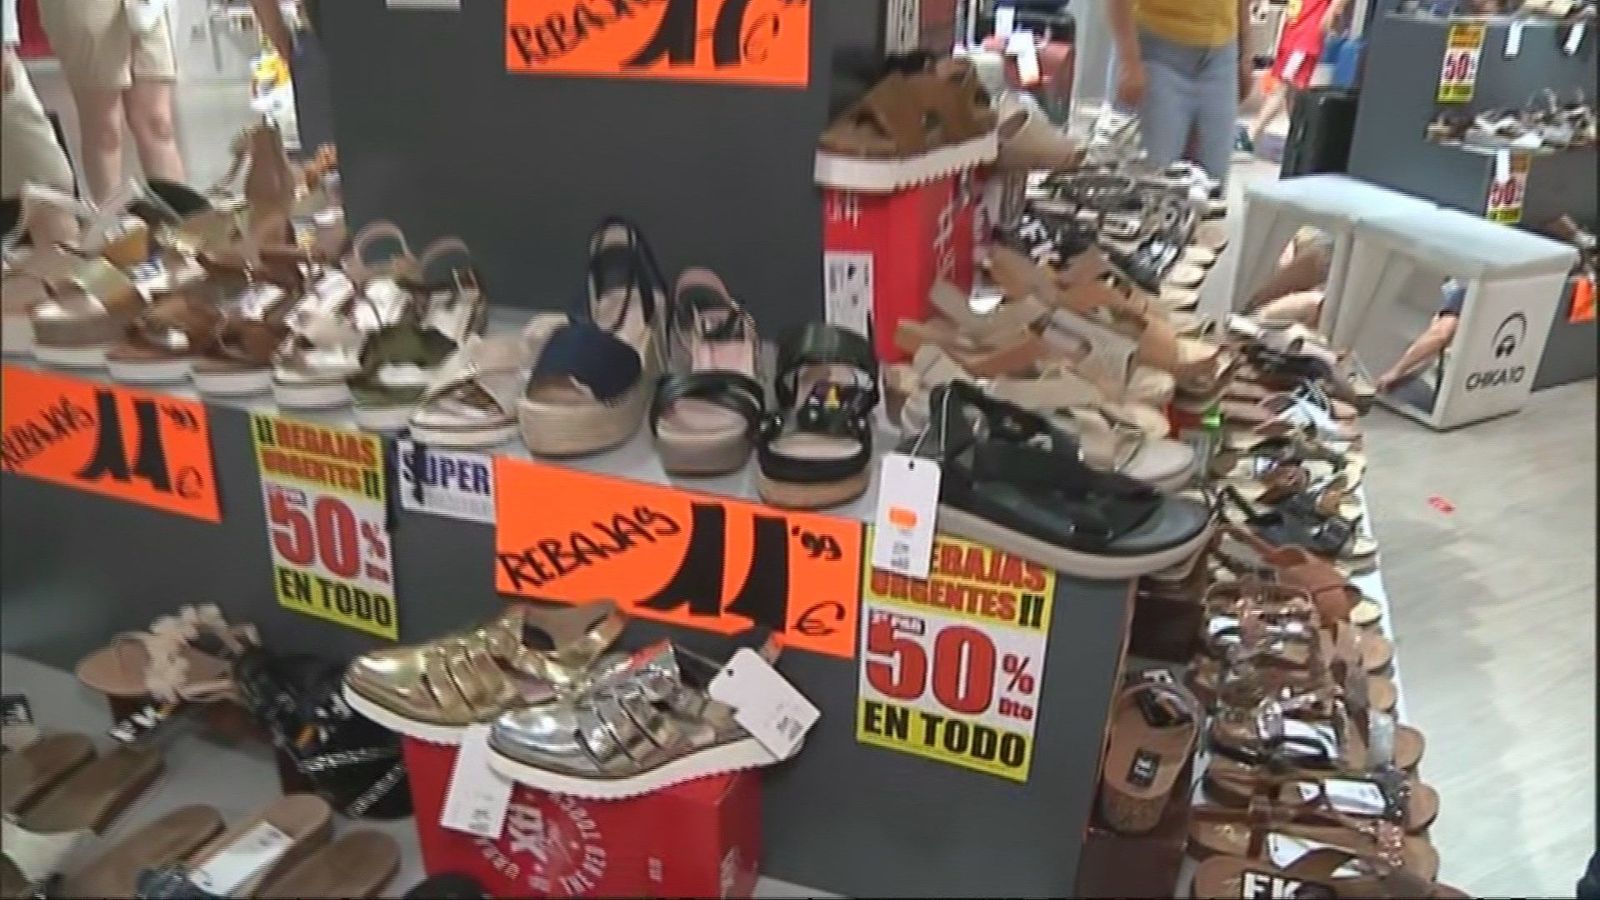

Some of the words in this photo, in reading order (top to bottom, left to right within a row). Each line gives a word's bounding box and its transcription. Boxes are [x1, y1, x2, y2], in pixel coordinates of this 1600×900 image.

[1444, 53, 1471, 82] 50
[268, 489, 361, 579] 50
[499, 505, 680, 590] REBAJAS
[277, 566, 312, 605] EN
[316, 577, 392, 627] TODO
[790, 601, 846, 637] €
[866, 617, 996, 715] 50
[864, 700, 909, 741] EN
[920, 712, 1026, 768] TODO
